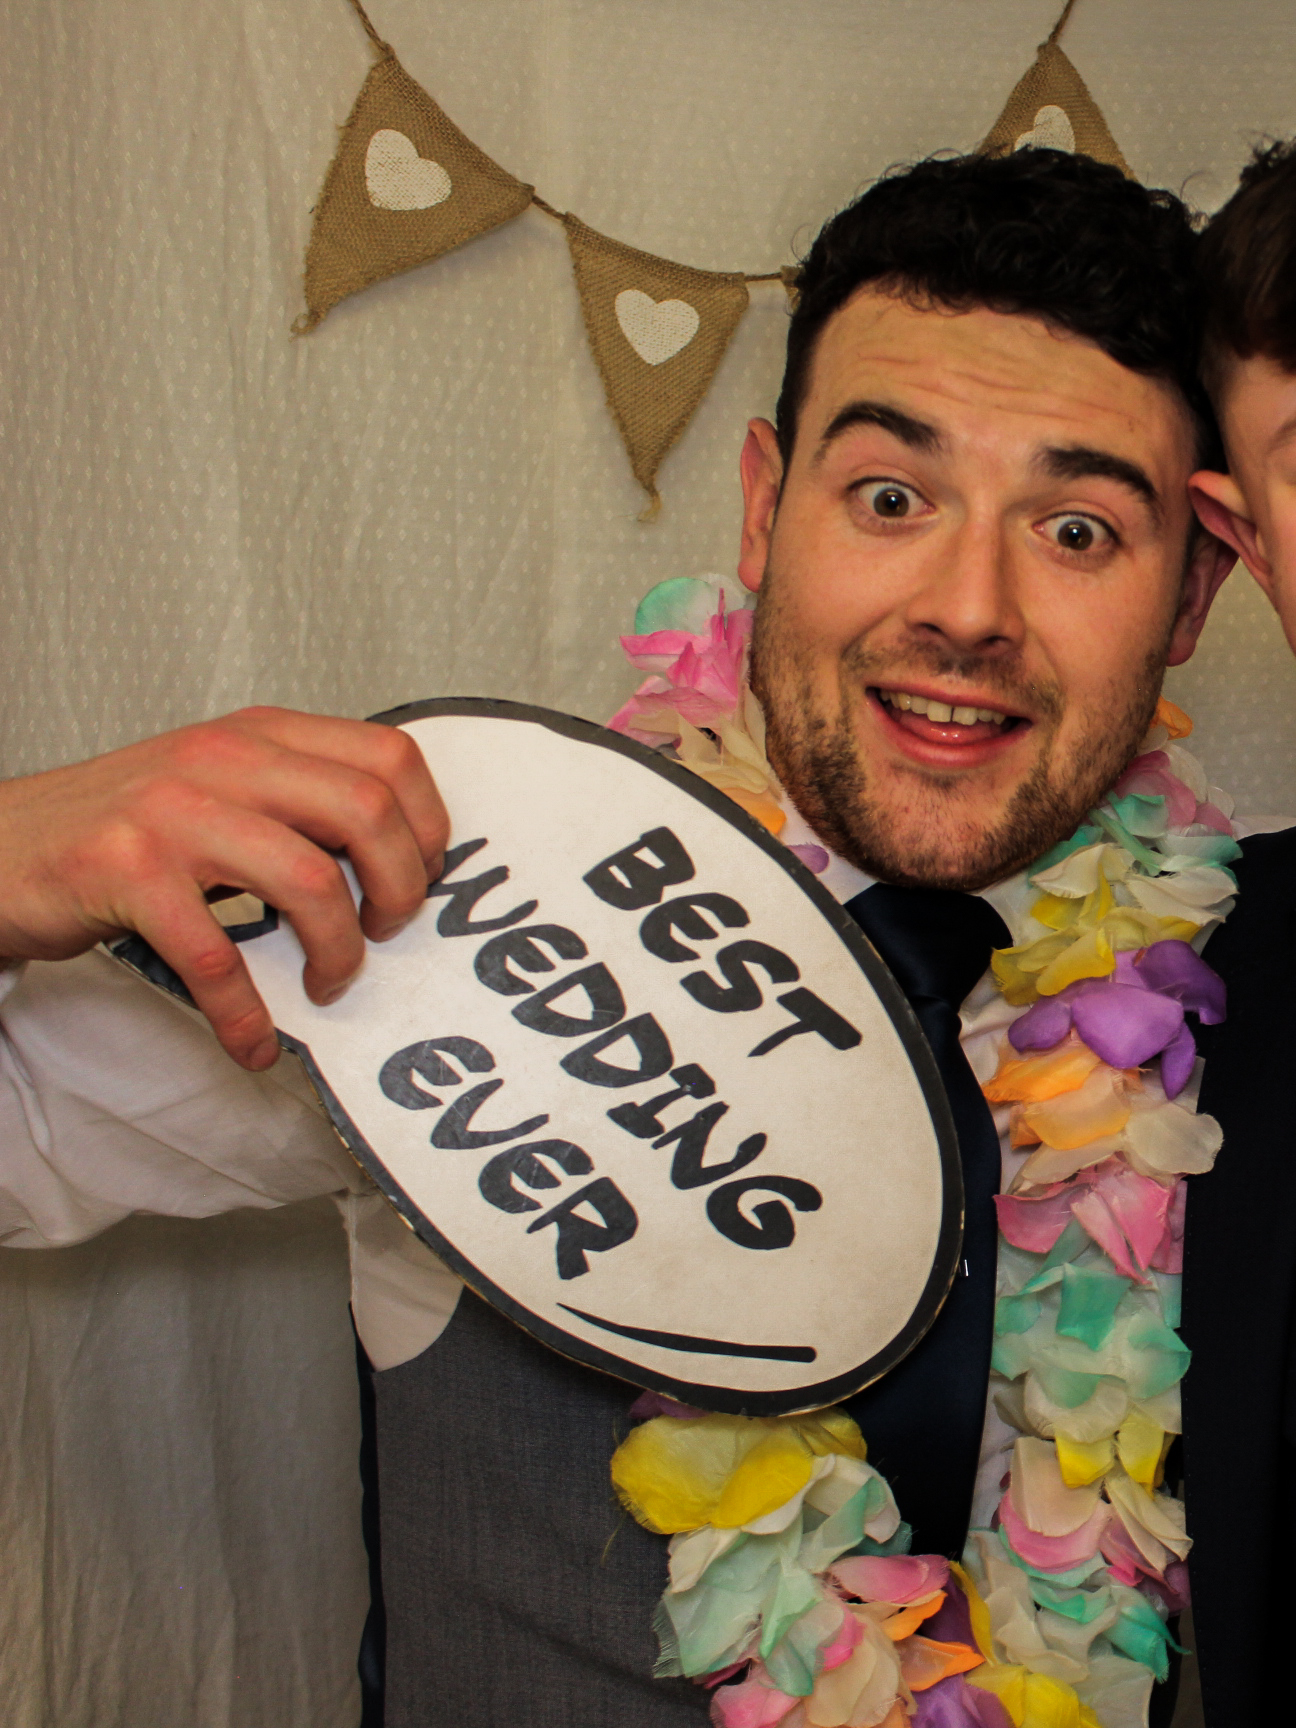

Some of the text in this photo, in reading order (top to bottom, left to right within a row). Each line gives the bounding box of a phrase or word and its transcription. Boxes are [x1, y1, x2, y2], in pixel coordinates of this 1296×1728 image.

[426, 837, 823, 1251] WEDDING
[582, 826, 863, 1058] BEST
[379, 1036, 639, 1280] EVER
